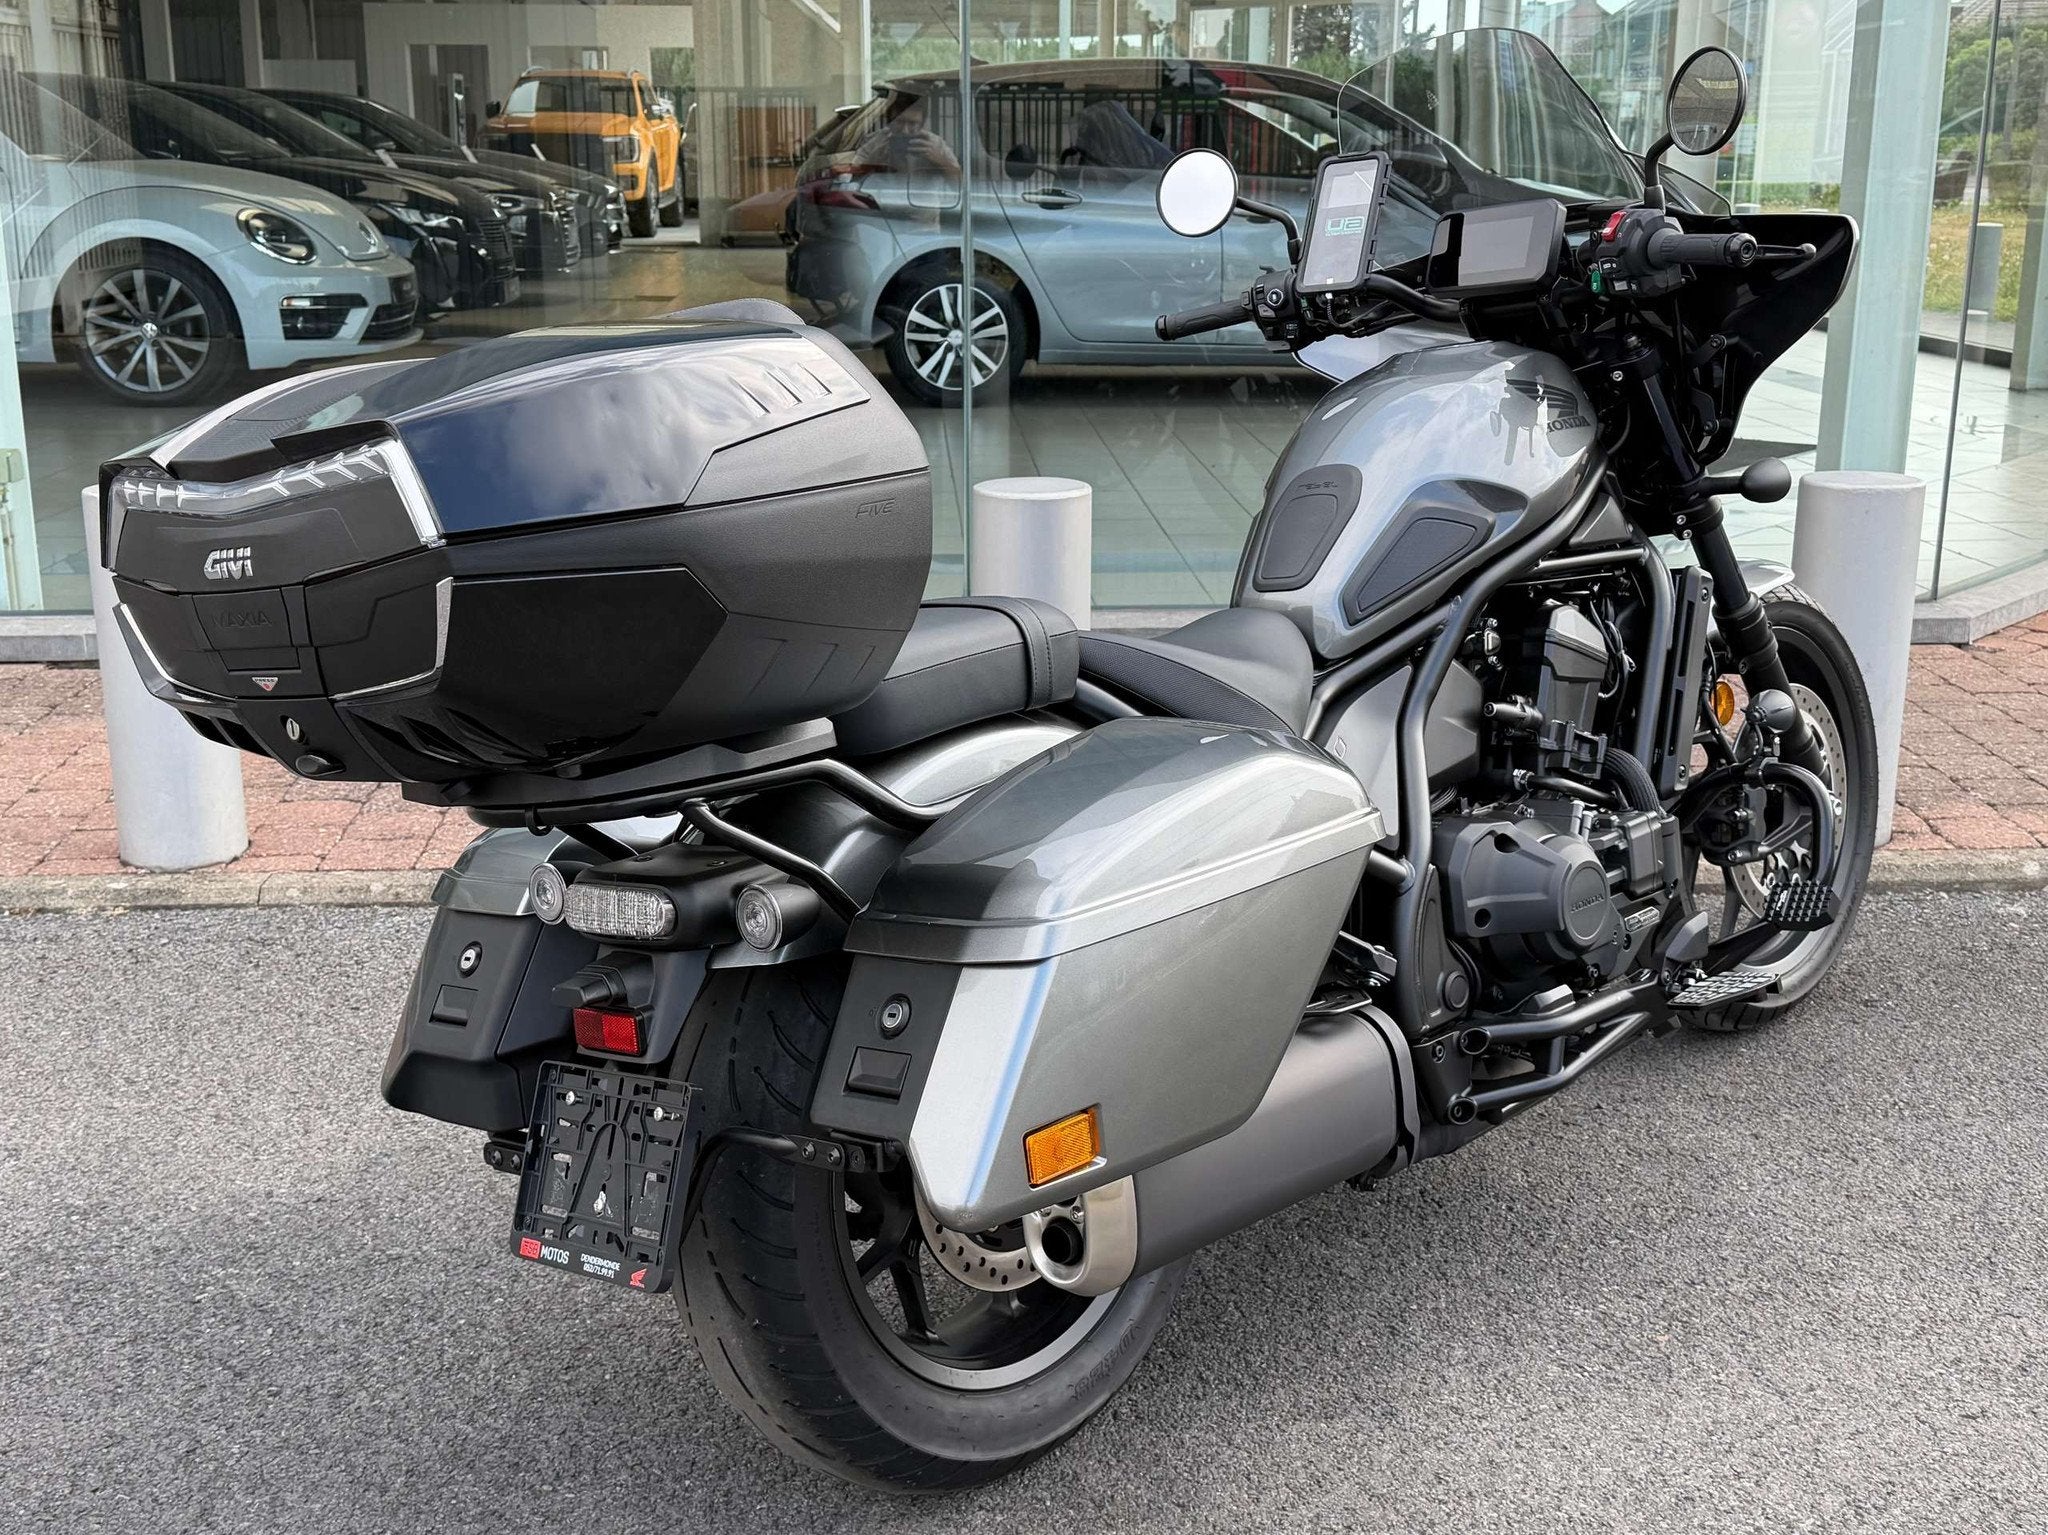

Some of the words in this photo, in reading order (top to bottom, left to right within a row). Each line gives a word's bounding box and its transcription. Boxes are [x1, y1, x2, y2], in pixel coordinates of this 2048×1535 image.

[854, 497, 896, 519] FIVE
[203, 546, 254, 580] GIVI
[1570, 893, 1605, 913] HONDA
[540, 1244, 570, 1265] MOTOS
